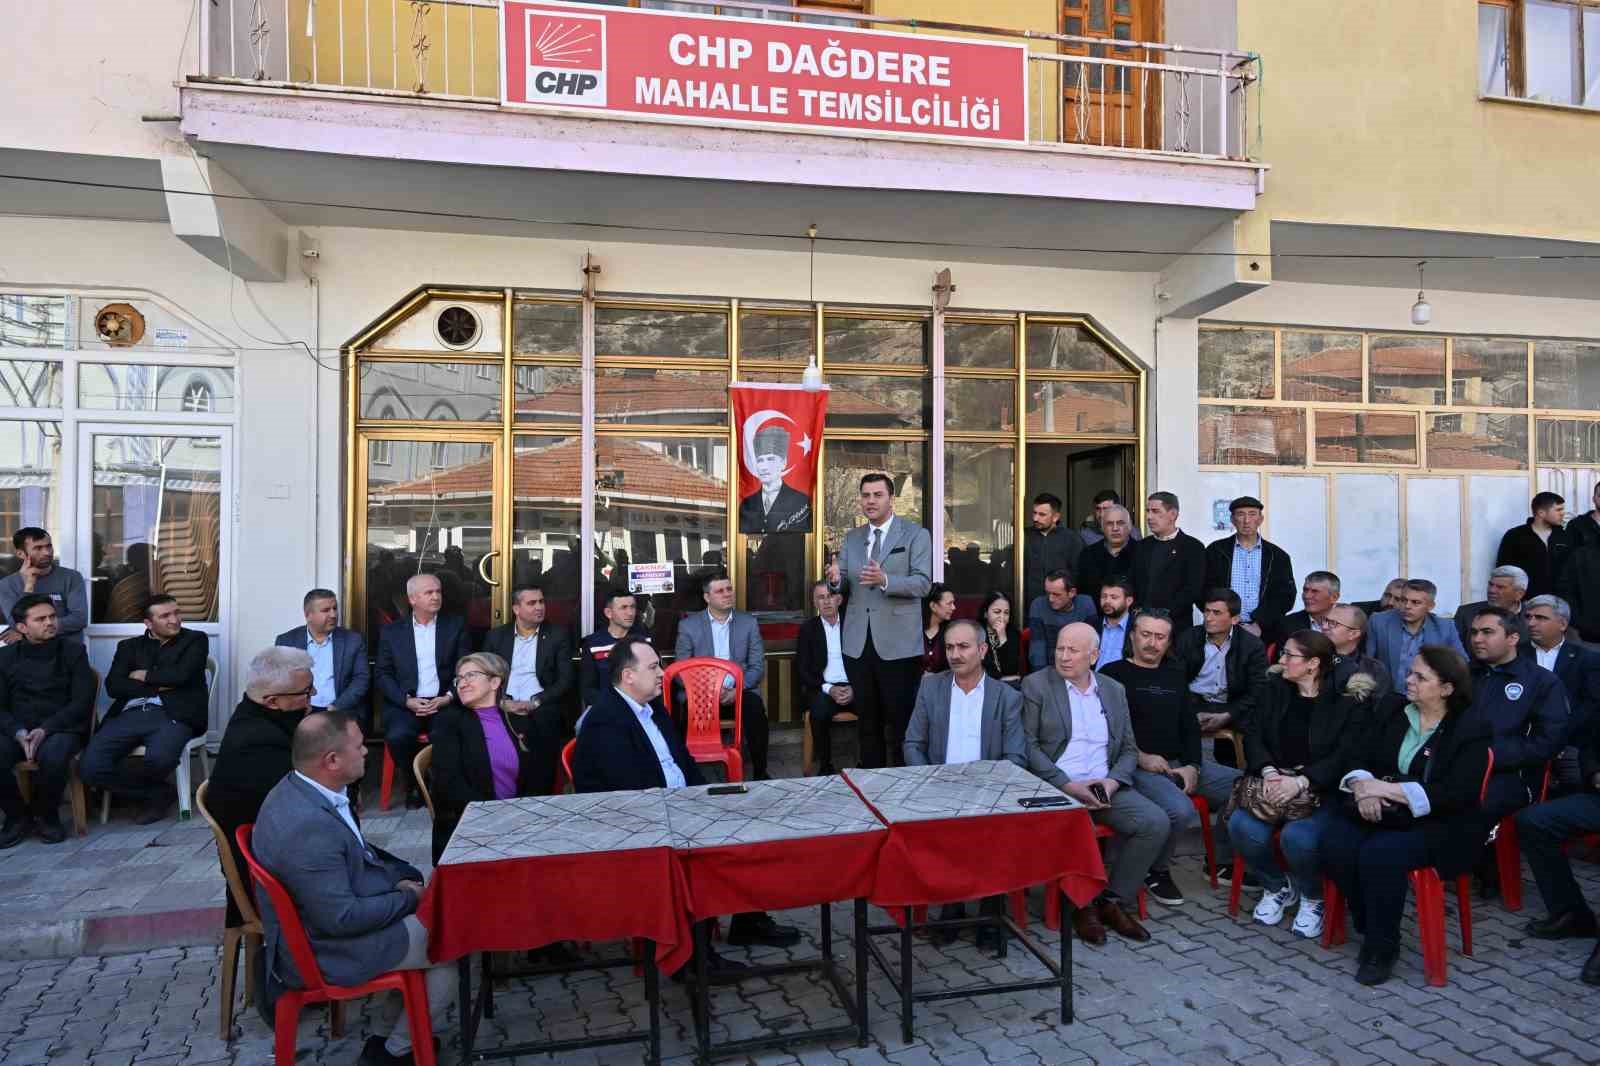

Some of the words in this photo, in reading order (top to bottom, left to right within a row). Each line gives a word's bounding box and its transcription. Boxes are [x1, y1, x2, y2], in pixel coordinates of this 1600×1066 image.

[535, 71, 597, 95] CHP
[669, 33, 753, 70] CHP
[767, 39, 951, 87] DAĞDERE
[635, 76, 789, 115] MAHALLE
[798, 89, 1000, 130] TEMSİLCİLİĞİ
